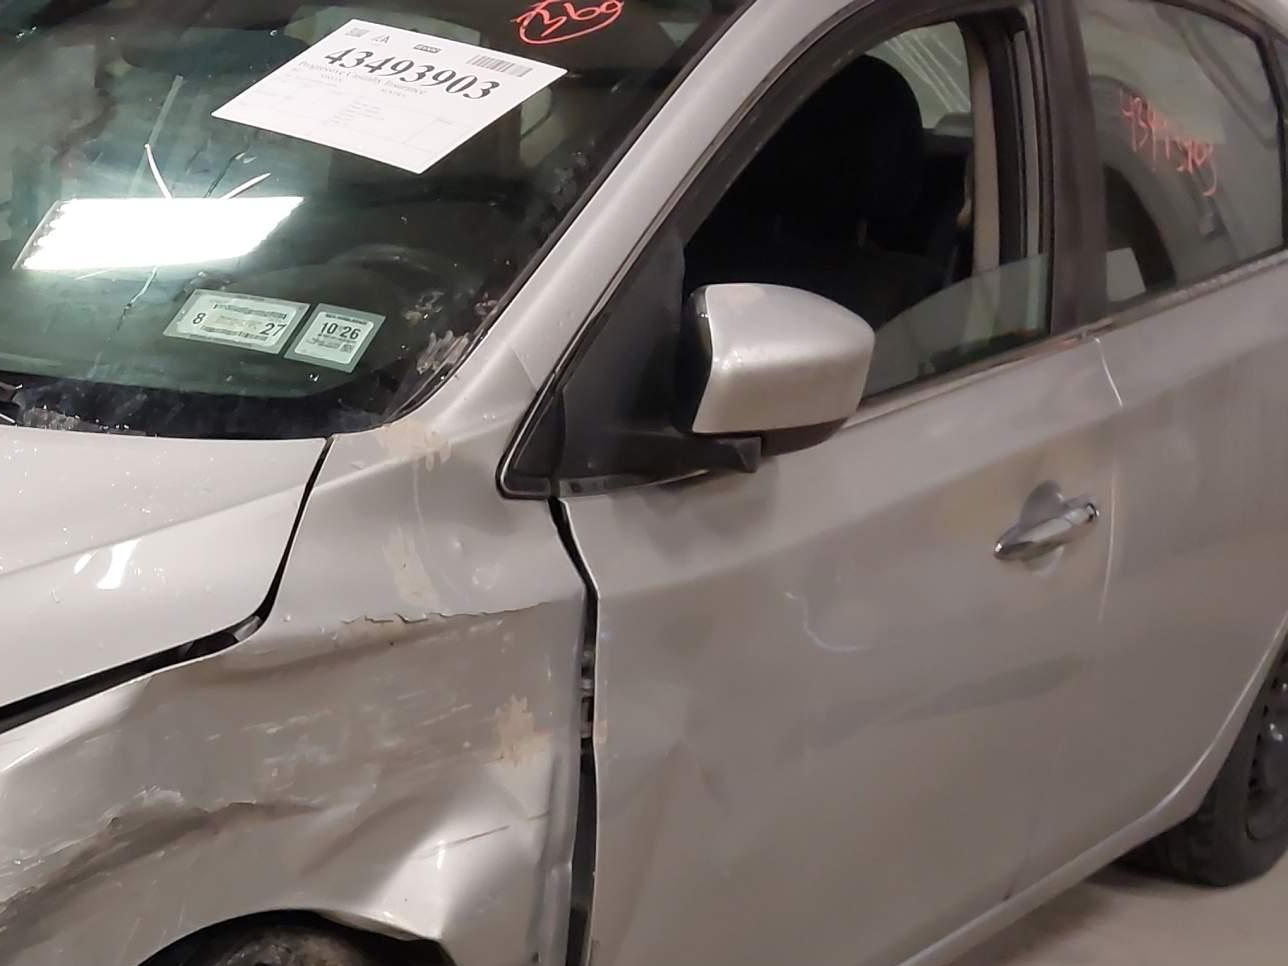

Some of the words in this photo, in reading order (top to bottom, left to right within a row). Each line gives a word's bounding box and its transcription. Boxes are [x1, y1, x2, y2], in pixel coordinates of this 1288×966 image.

[323, 46, 502, 100] 43493903
[192, 312, 206, 325] 8
[259, 322, 287, 337] 27
[320, 321, 338, 335] 10
[339, 325, 361, 340] 26
